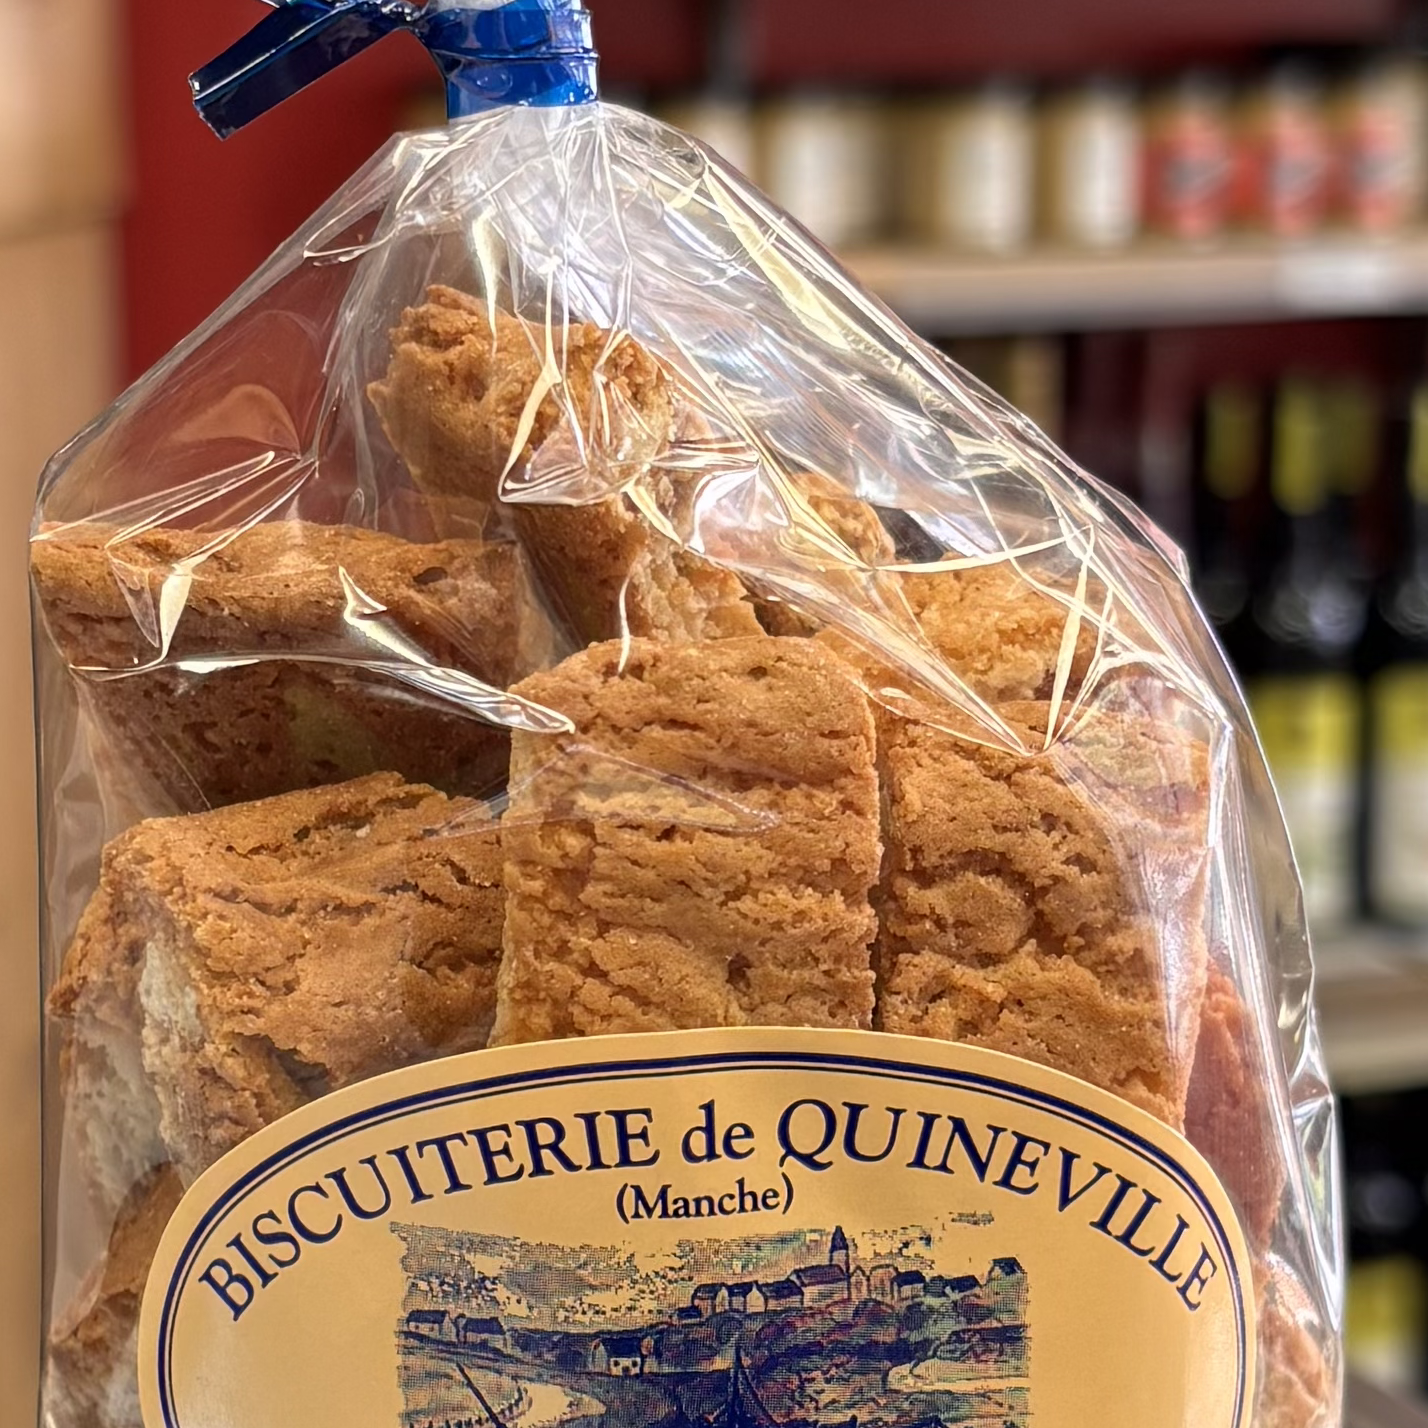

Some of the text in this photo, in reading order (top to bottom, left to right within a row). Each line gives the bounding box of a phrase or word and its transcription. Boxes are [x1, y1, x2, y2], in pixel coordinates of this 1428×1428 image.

[196, 1097, 1218, 1323] BISCUITERIE de QUINEVILLE
[615, 1176, 795, 1226] (Manche)
